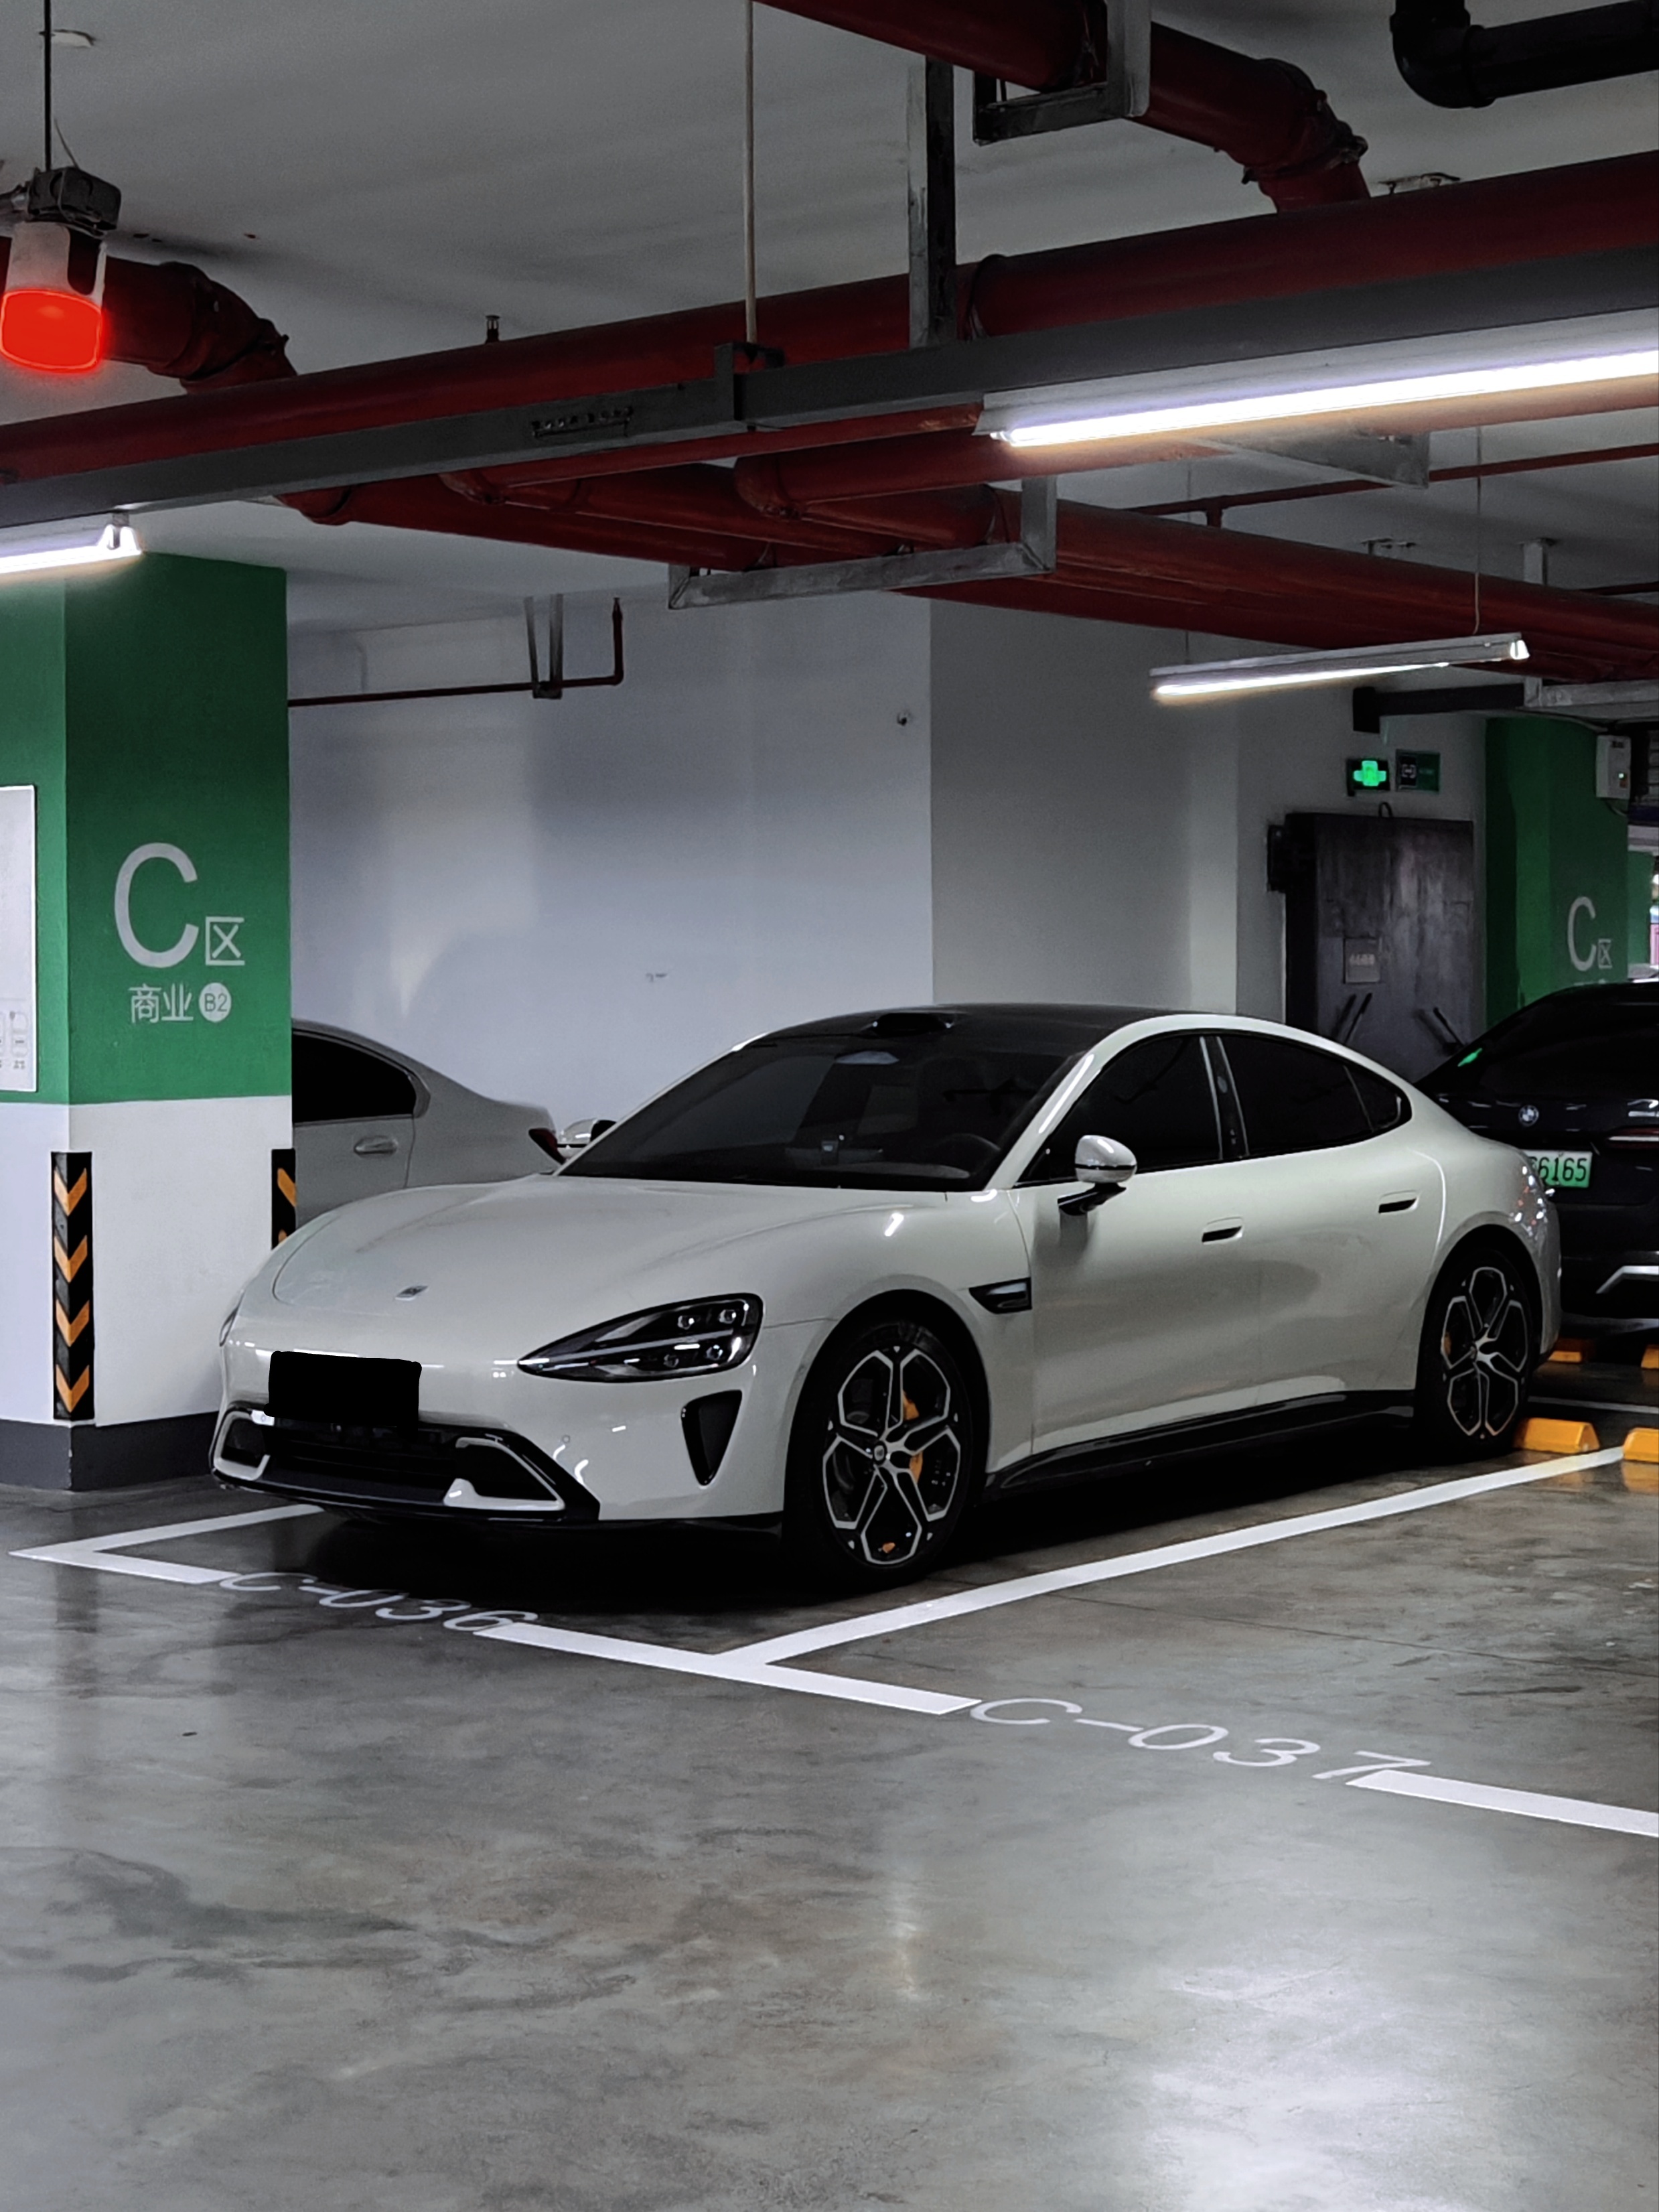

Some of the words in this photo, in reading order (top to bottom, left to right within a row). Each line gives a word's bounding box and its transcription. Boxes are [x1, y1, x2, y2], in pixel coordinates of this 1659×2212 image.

[115, 842, 245, 968] C区
[1567, 896, 1613, 971] C区
[128, 983, 194, 1024] 商业
[204, 992, 228, 1013] B2
[219, 1572, 538, 1631] C-036
[970, 1697, 1431, 1780] C-037
